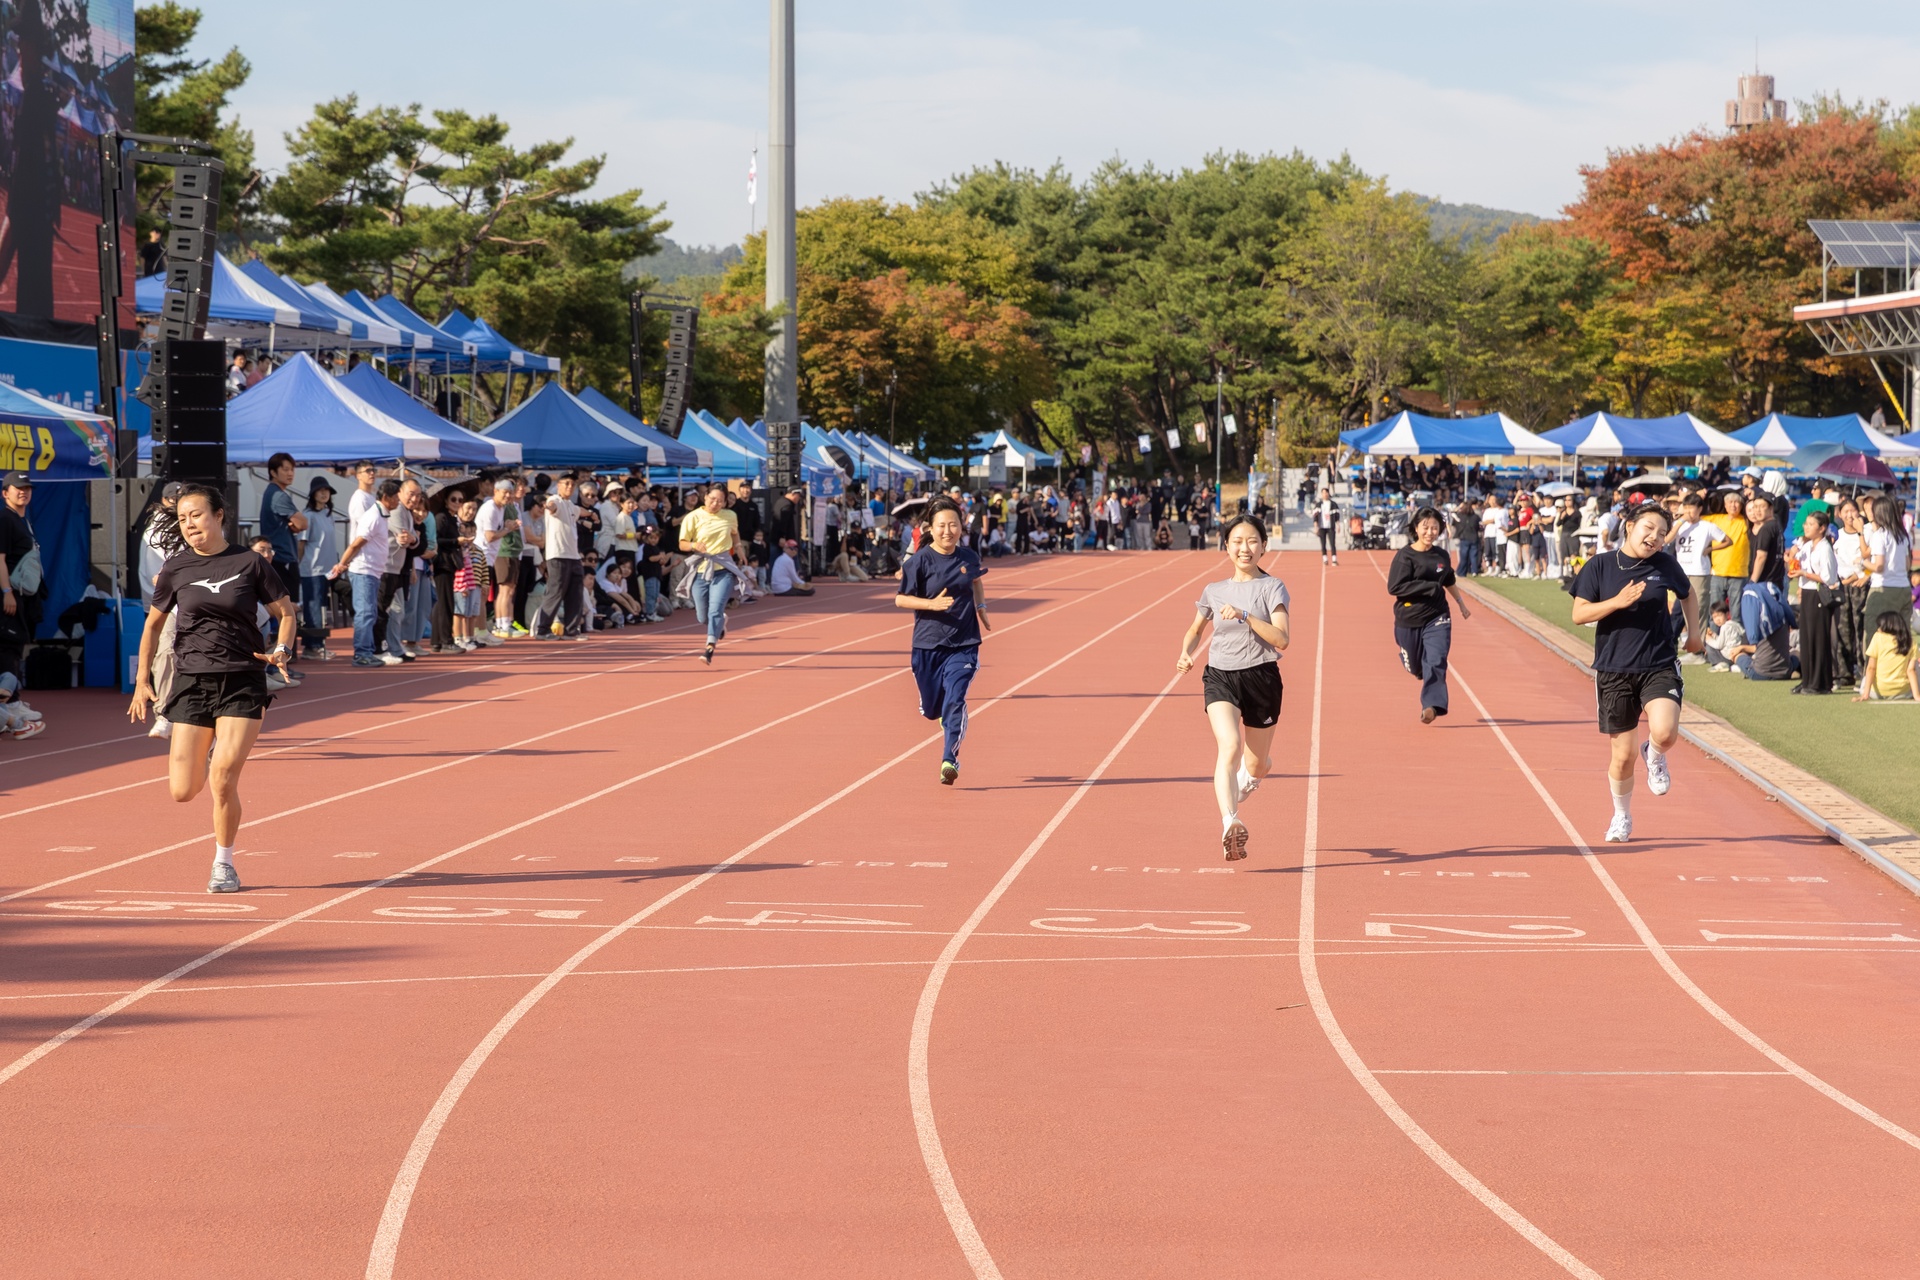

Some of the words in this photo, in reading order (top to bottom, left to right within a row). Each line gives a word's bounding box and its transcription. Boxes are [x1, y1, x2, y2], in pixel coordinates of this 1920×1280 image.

[35, 427, 56, 471] B
[372, 906, 587, 919] 5
[694, 909, 913, 926] 4
[1029, 916, 1252, 935] 3
[1364, 921, 1587, 939] 2
[1699, 929, 1920, 943] 1
